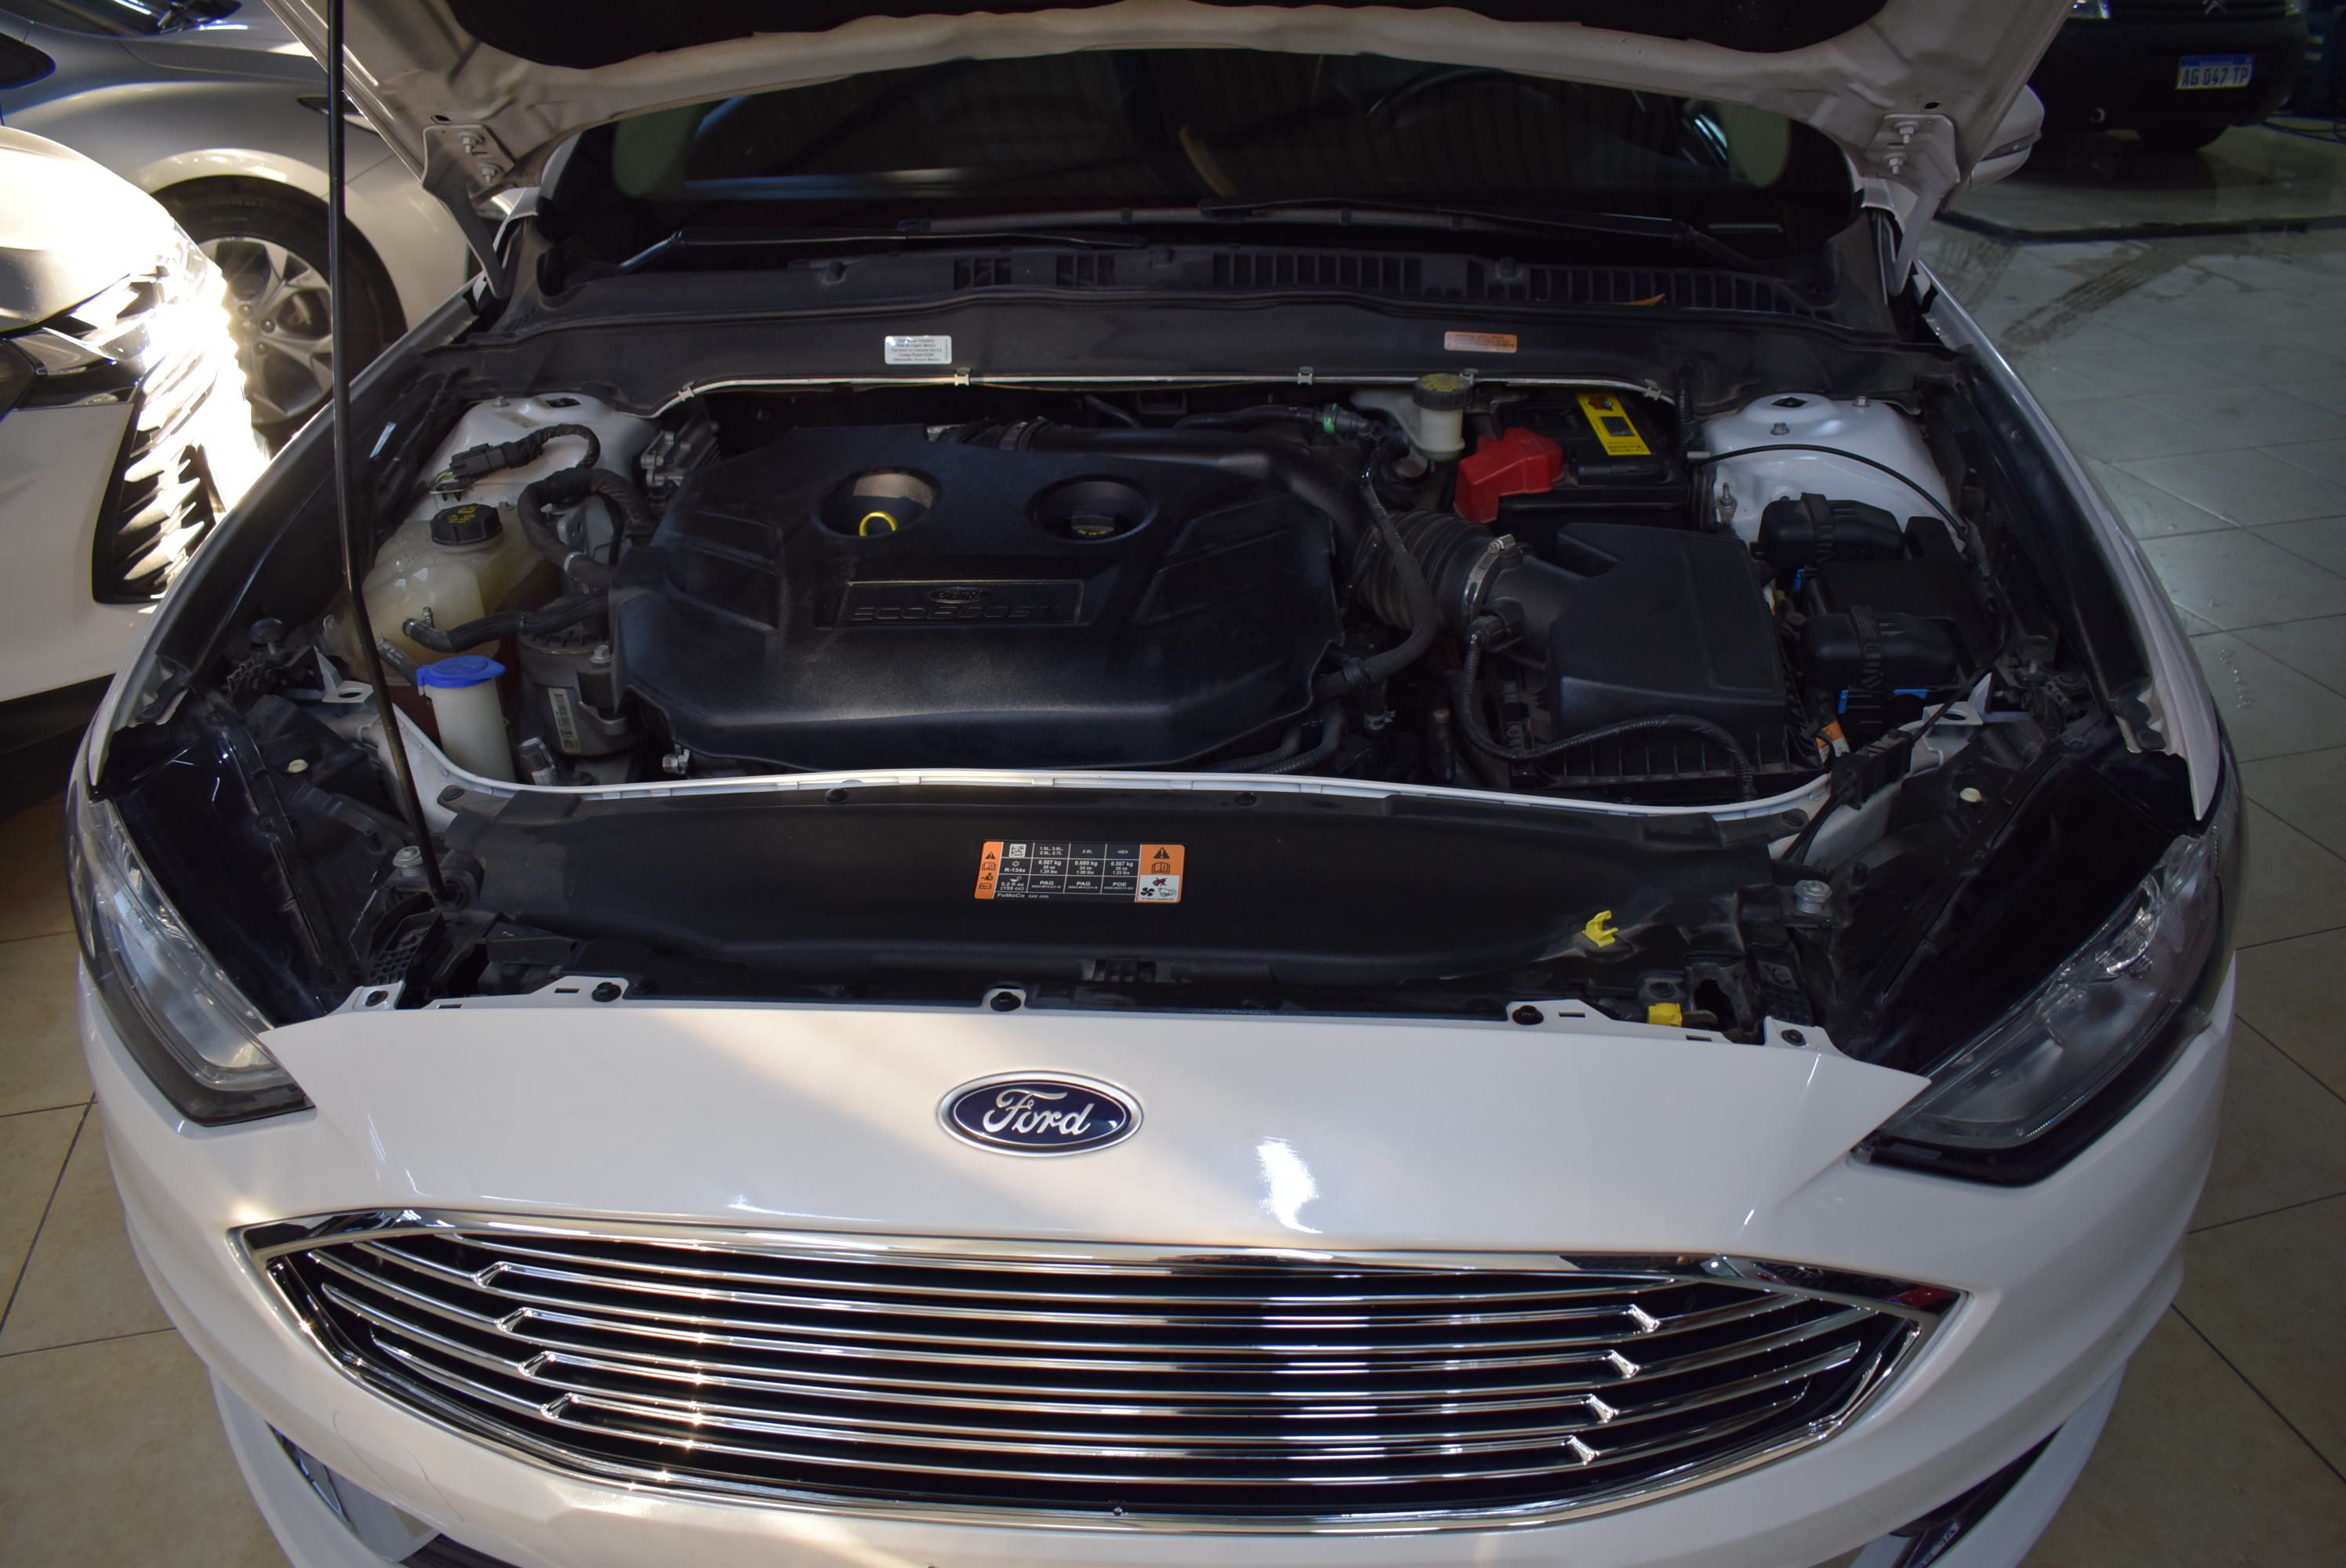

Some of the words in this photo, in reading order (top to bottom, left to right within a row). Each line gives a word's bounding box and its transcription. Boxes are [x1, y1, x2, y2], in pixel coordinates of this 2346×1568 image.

[2182, 68, 2199, 85] AG
[2203, 67, 2228, 85] 047
[2233, 67, 2248, 84] TP
[982, 1088, 1095, 1135] Ford
